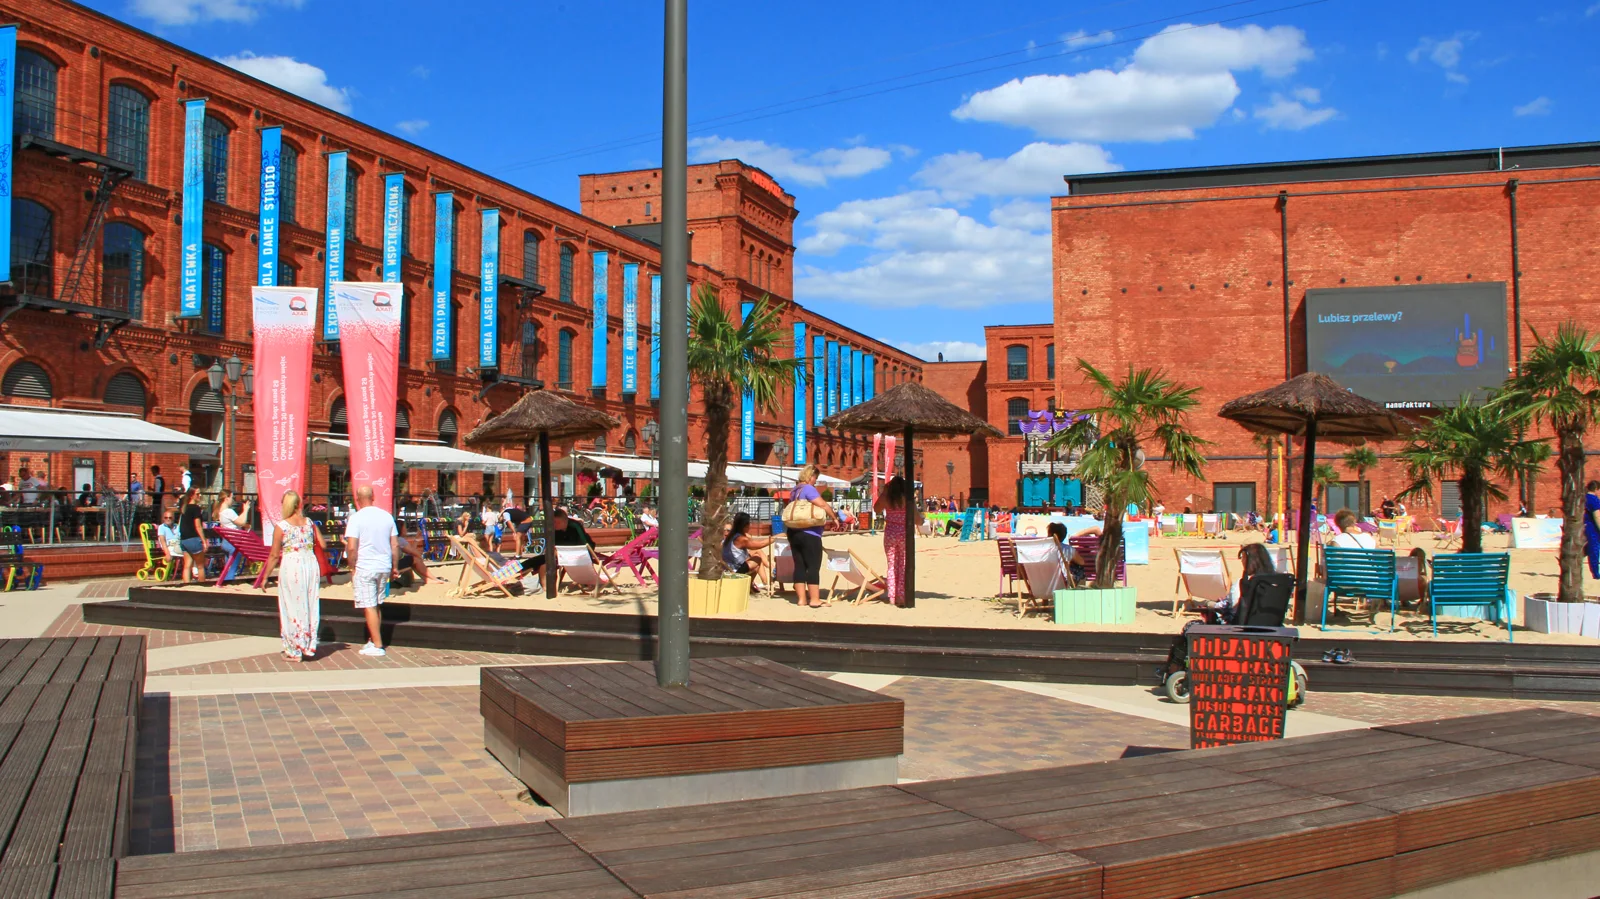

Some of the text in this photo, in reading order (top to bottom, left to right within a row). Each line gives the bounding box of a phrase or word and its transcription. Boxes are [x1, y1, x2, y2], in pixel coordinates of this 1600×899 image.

[262, 165, 275, 287] OLA DANCE STUDIO
[387, 185, 399, 266] WSPINACZKOWA
[185, 243, 197, 309] ANATEWKA
[436, 291, 446, 354] JAZDA!PARK
[483, 262, 494, 362] ARENA LASER GAMES
[1318, 311, 1403, 323] Lubisz przelewy?
[626, 303, 635, 389] MAX ICE AND COFFEE
[744, 410, 752, 457] MANUFAKTURA
[1195, 713, 1281, 735] GARBAGE
